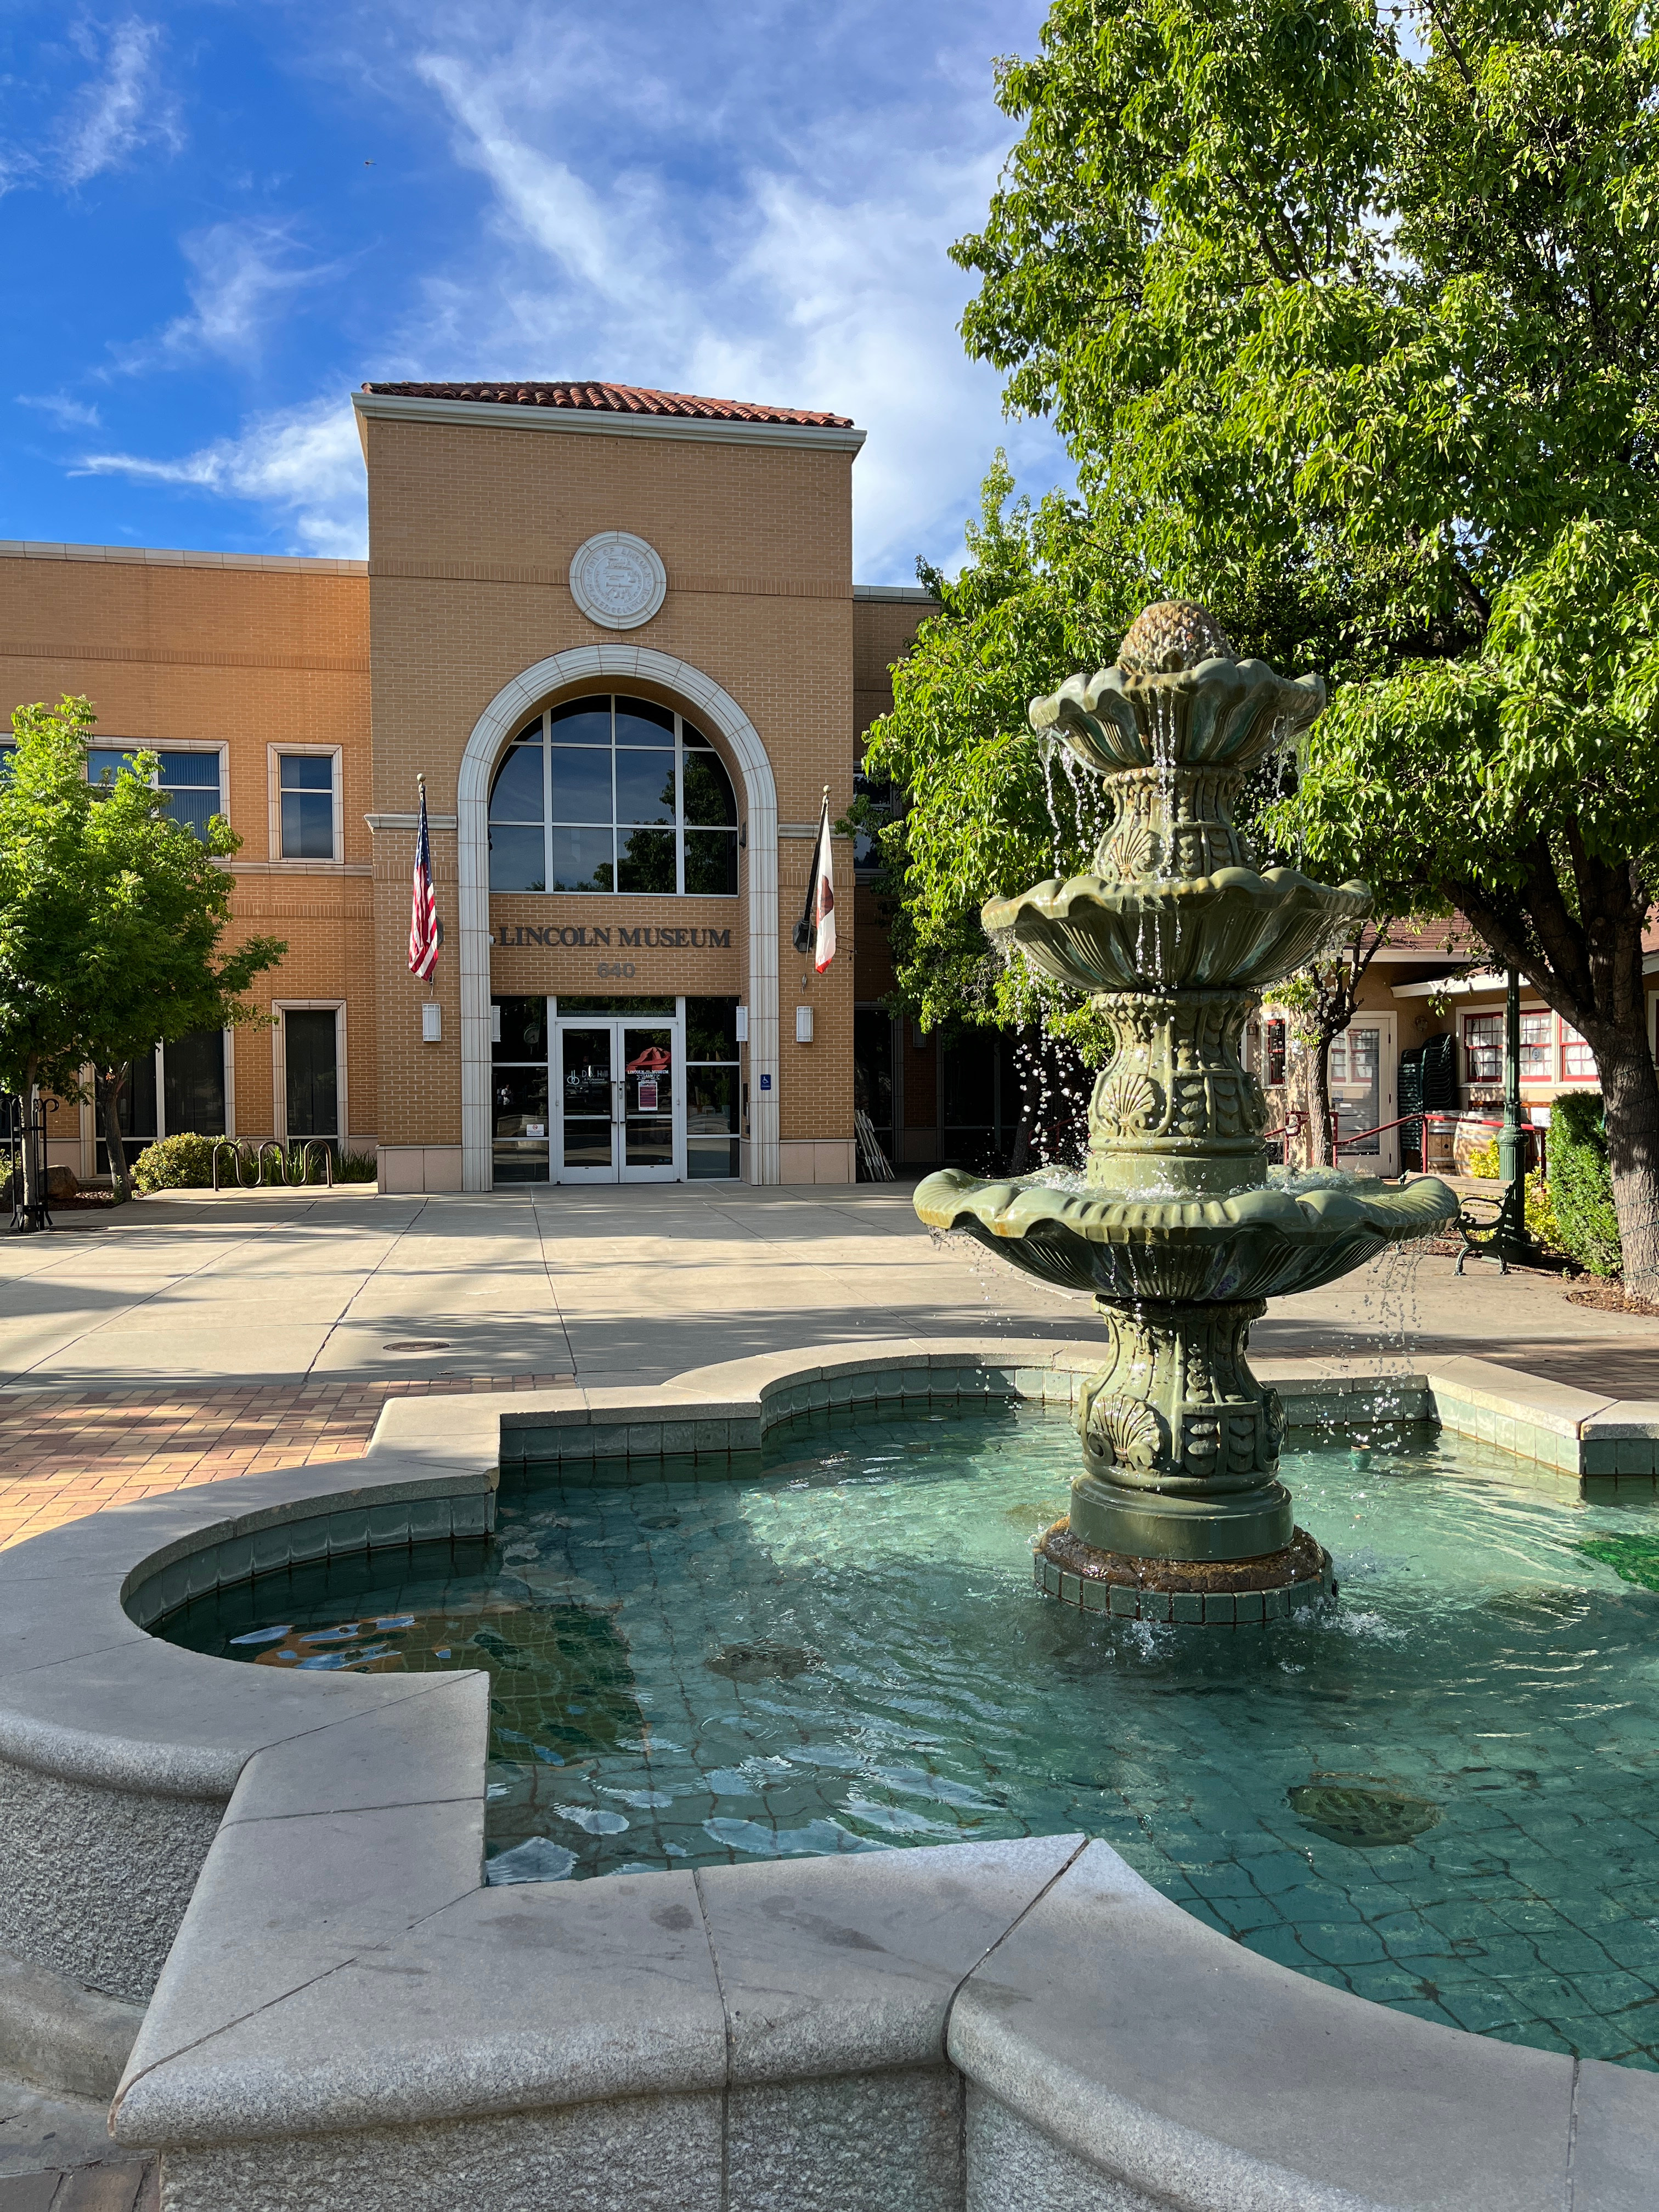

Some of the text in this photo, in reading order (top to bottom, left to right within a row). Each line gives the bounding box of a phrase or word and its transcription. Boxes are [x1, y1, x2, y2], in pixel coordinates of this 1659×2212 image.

[602, 548, 615, 556] OF
[621, 549, 652, 578] LINCOLN
[499, 927, 731, 947] LINCOLN MUSEUM
[597, 962, 635, 978] 640
